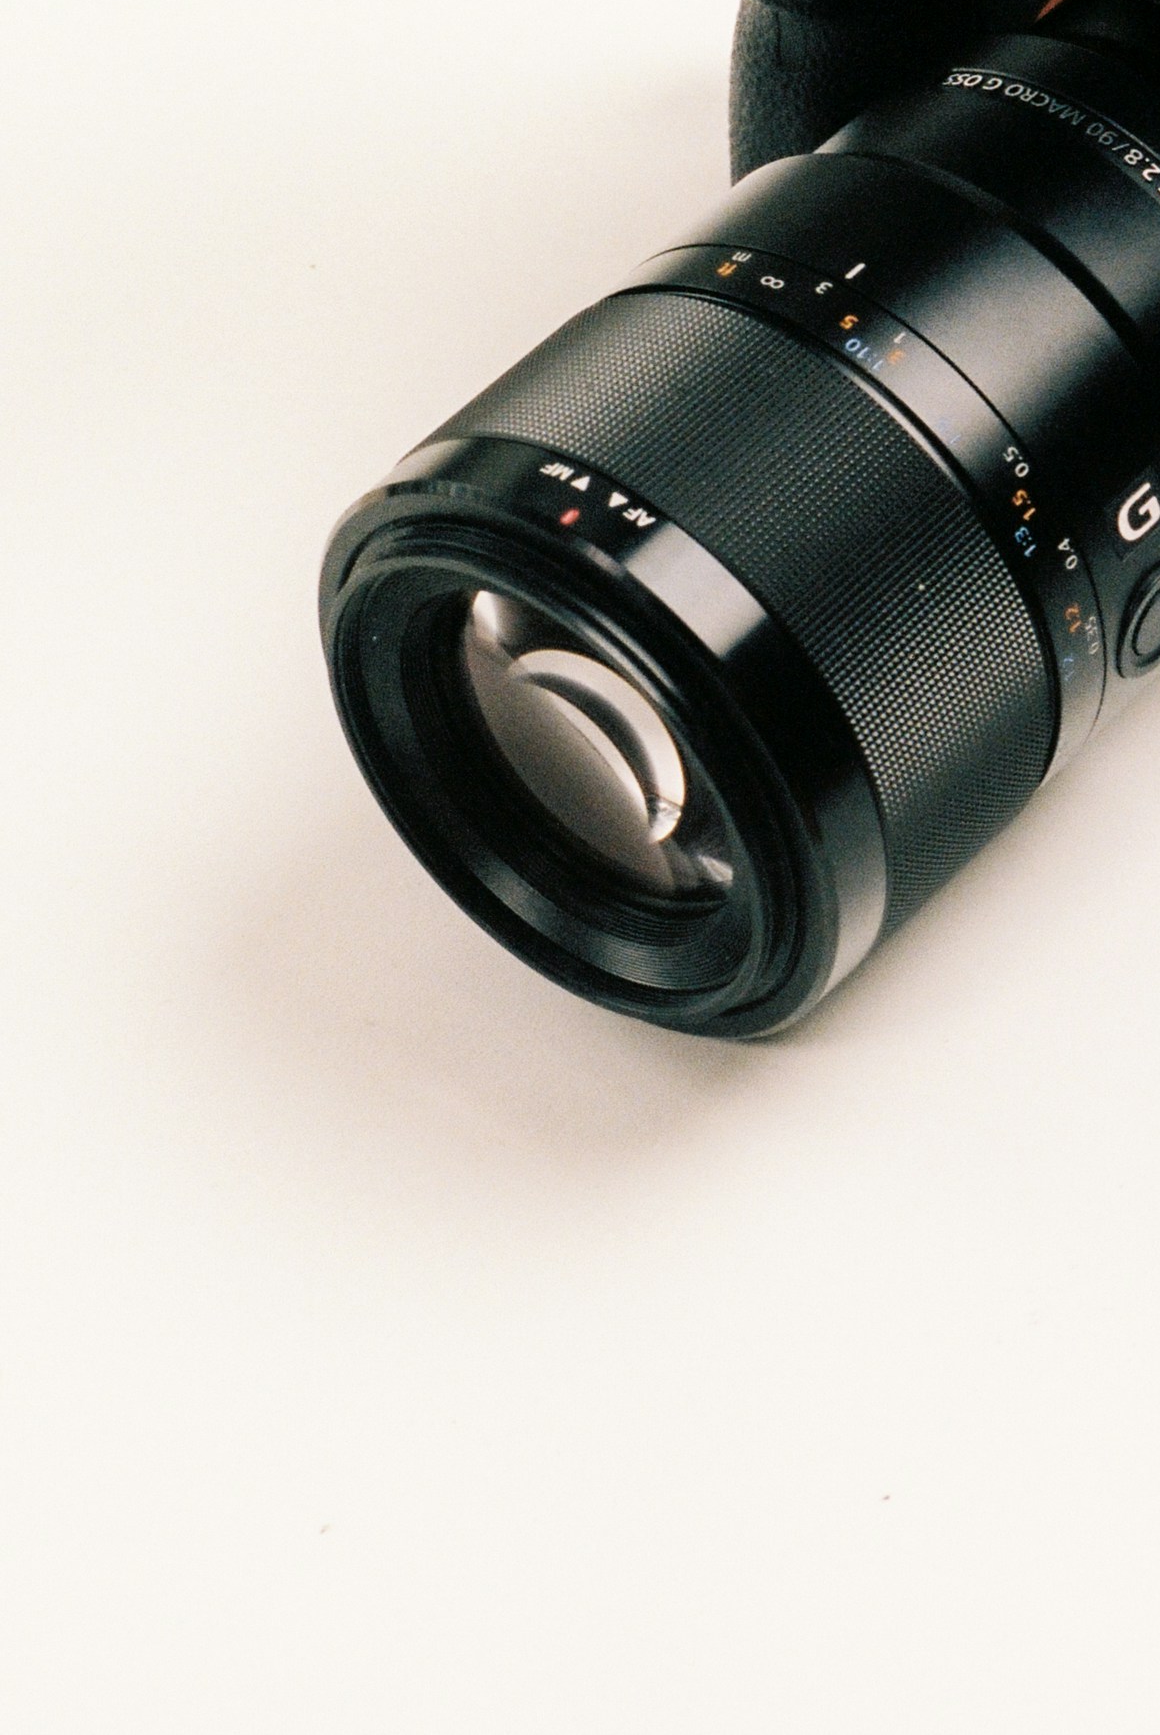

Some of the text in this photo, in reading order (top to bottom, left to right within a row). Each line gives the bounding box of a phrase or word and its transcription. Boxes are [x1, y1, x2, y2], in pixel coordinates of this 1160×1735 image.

[982, 76, 1003, 91] G
[1004, 82, 1085, 127] MACRO
[814, 281, 834, 295] 3
[539, 462, 575, 482] MF
[1002, 446, 1030, 478] 0.5
[622, 507, 657, 528] AF
[1011, 488, 1037, 522] 1.5
[1057, 537, 1078, 570] 0.4
